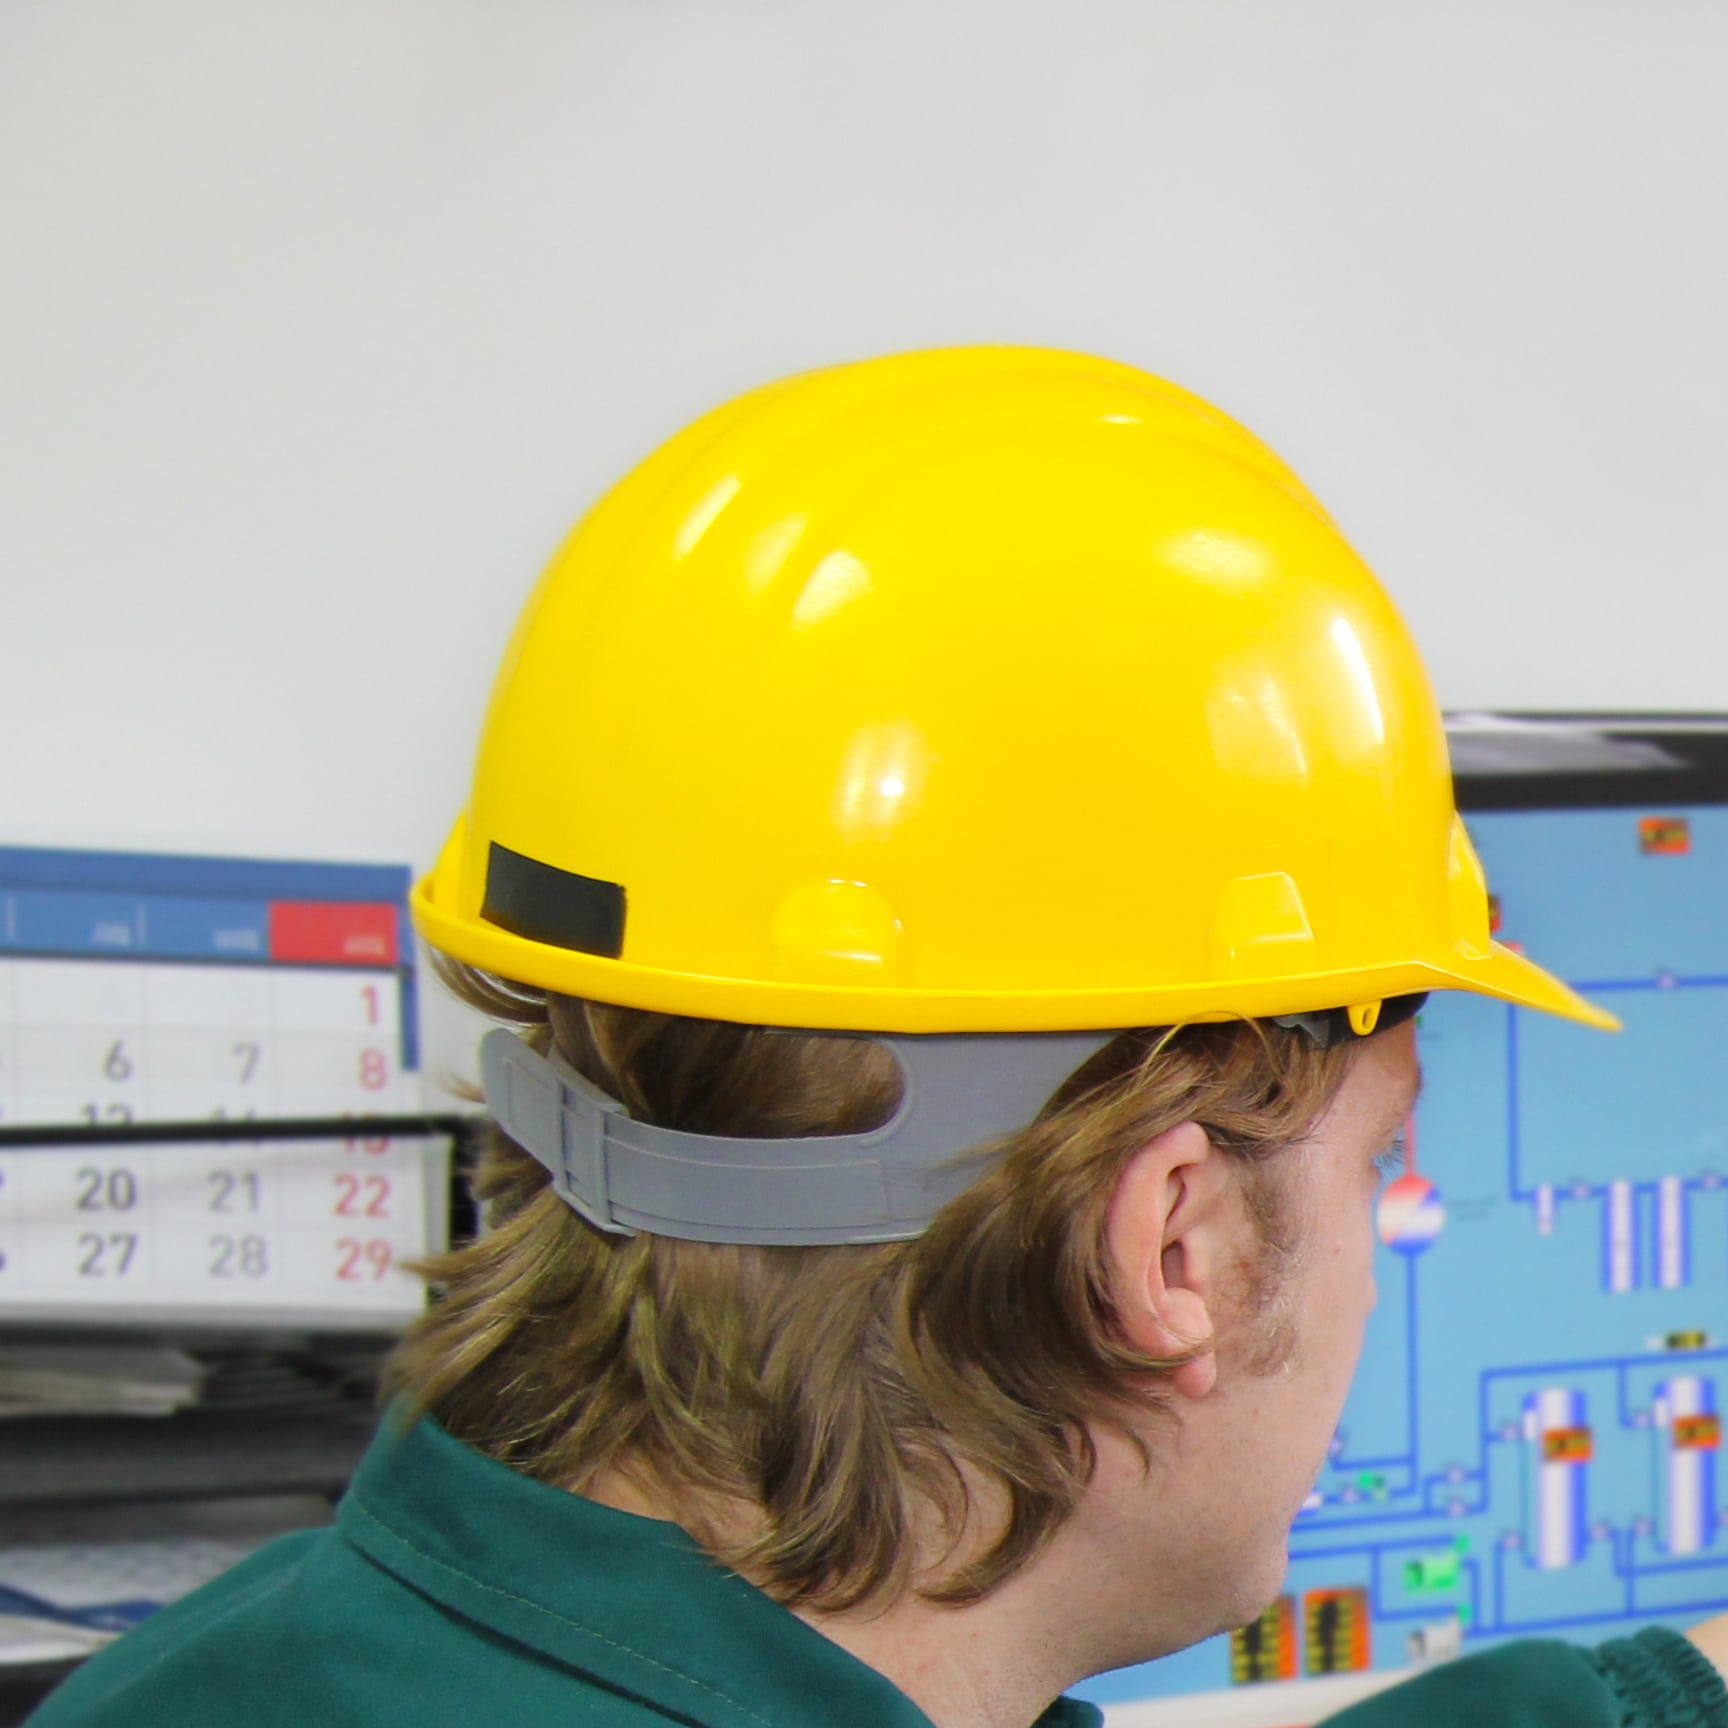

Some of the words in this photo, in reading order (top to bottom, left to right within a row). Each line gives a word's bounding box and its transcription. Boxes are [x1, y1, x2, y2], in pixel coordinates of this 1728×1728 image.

[361, 985, 380, 1026] 1
[104, 1040, 133, 1082] 6
[233, 1043, 260, 1085] 7
[359, 1048, 387, 1090] 8
[75, 1167, 138, 1212] 20
[207, 1171, 260, 1213] 21
[333, 1173, 390, 1219] 22
[77, 1232, 138, 1276] 27
[209, 1233, 268, 1278] 28
[335, 1236, 393, 1283] 29
